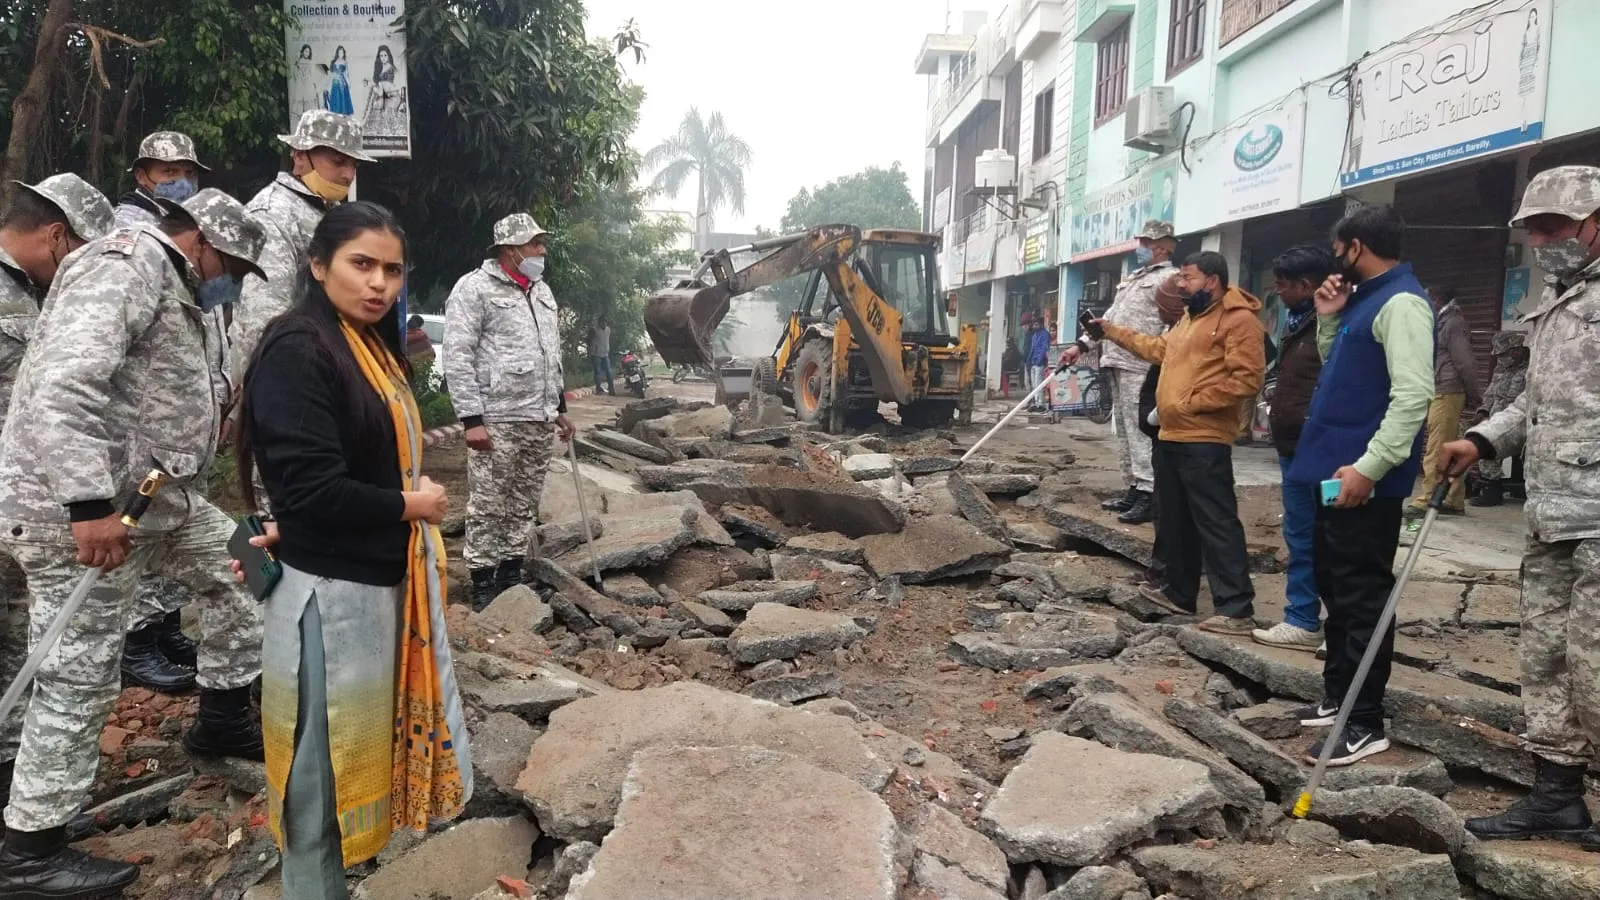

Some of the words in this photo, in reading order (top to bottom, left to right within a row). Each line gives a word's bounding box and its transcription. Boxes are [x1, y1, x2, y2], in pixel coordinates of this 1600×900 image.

[290, 4, 339, 16] Collection
[342, 5, 349, 15] &
[353, 4, 396, 17] Boutique
[1388, 20, 1493, 102] Raj
[1378, 109, 1430, 144] Ladies
[1435, 89, 1501, 127] Tailors
